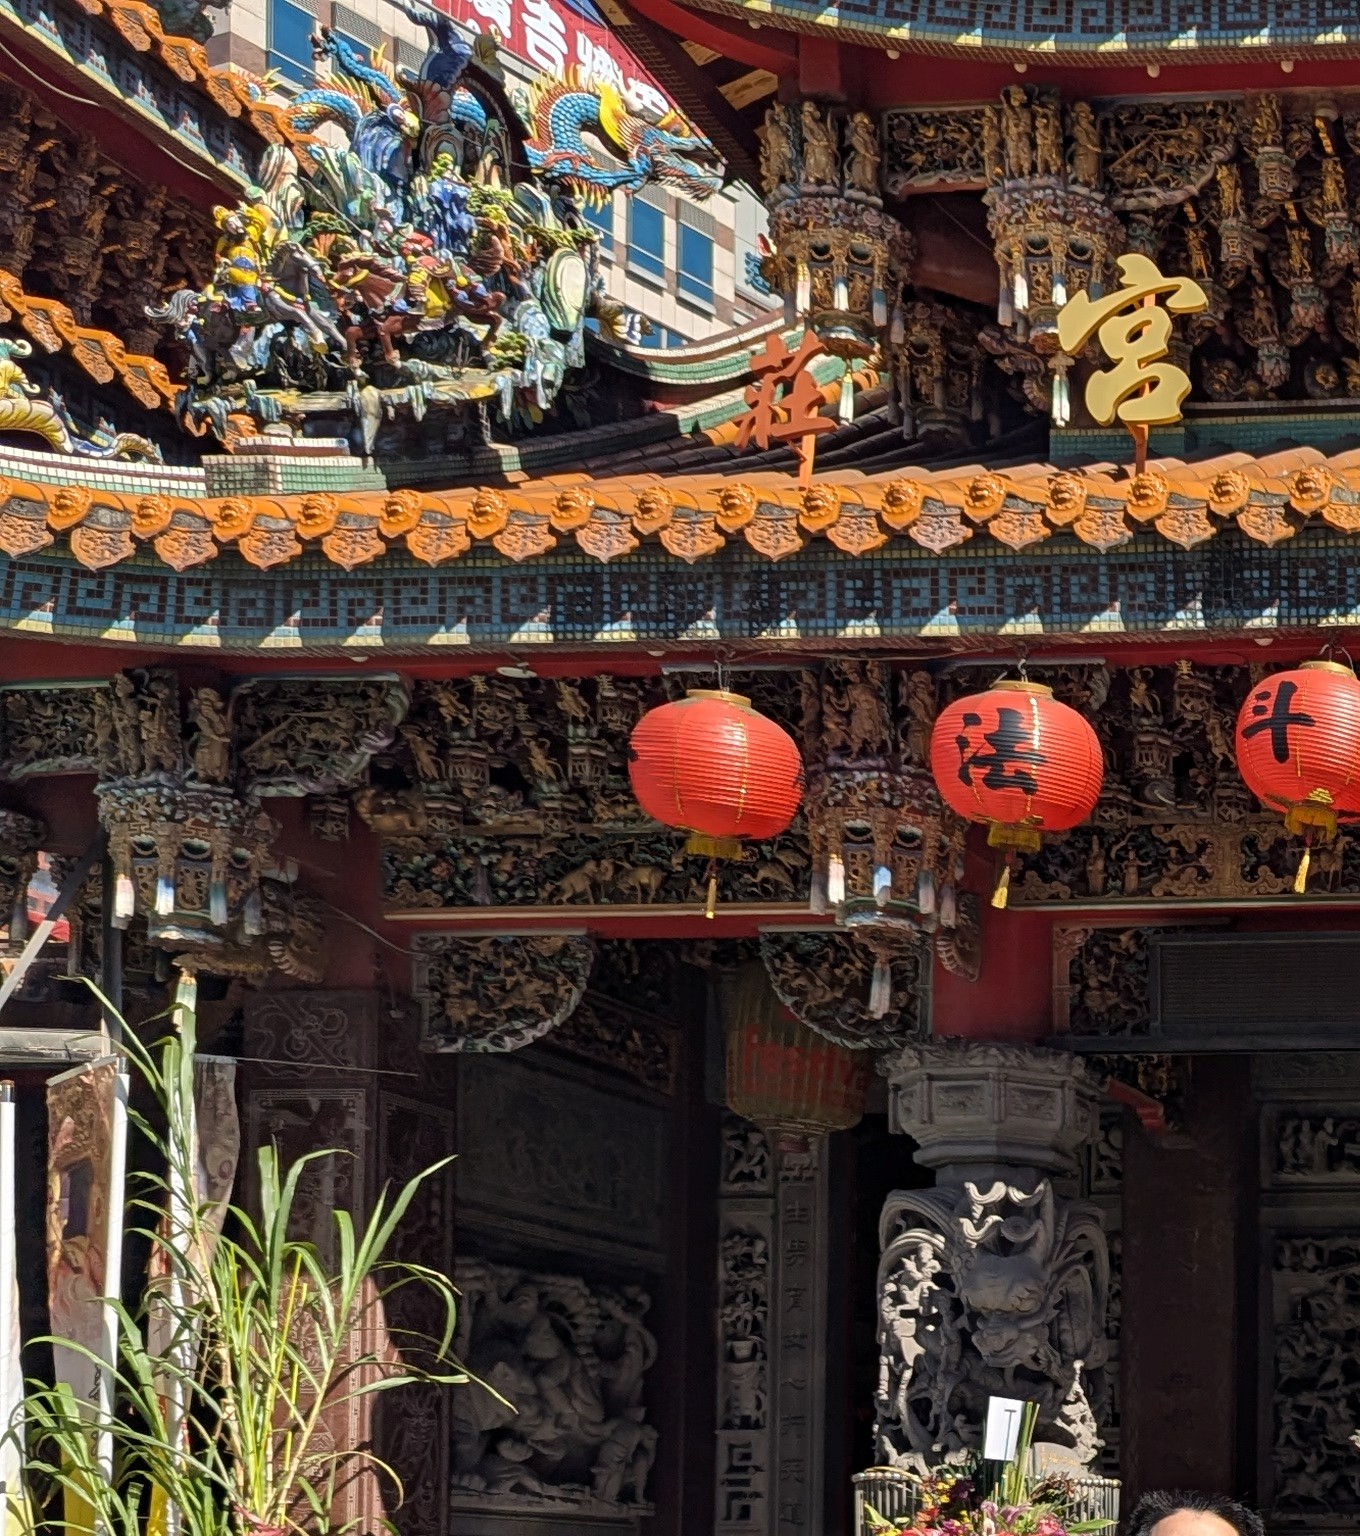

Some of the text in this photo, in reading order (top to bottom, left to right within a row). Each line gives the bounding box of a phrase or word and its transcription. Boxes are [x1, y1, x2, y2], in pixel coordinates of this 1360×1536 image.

[734, 330, 838, 450] 莊
[957, 709, 1046, 796] 法
[1243, 681, 1315, 764] 斗
